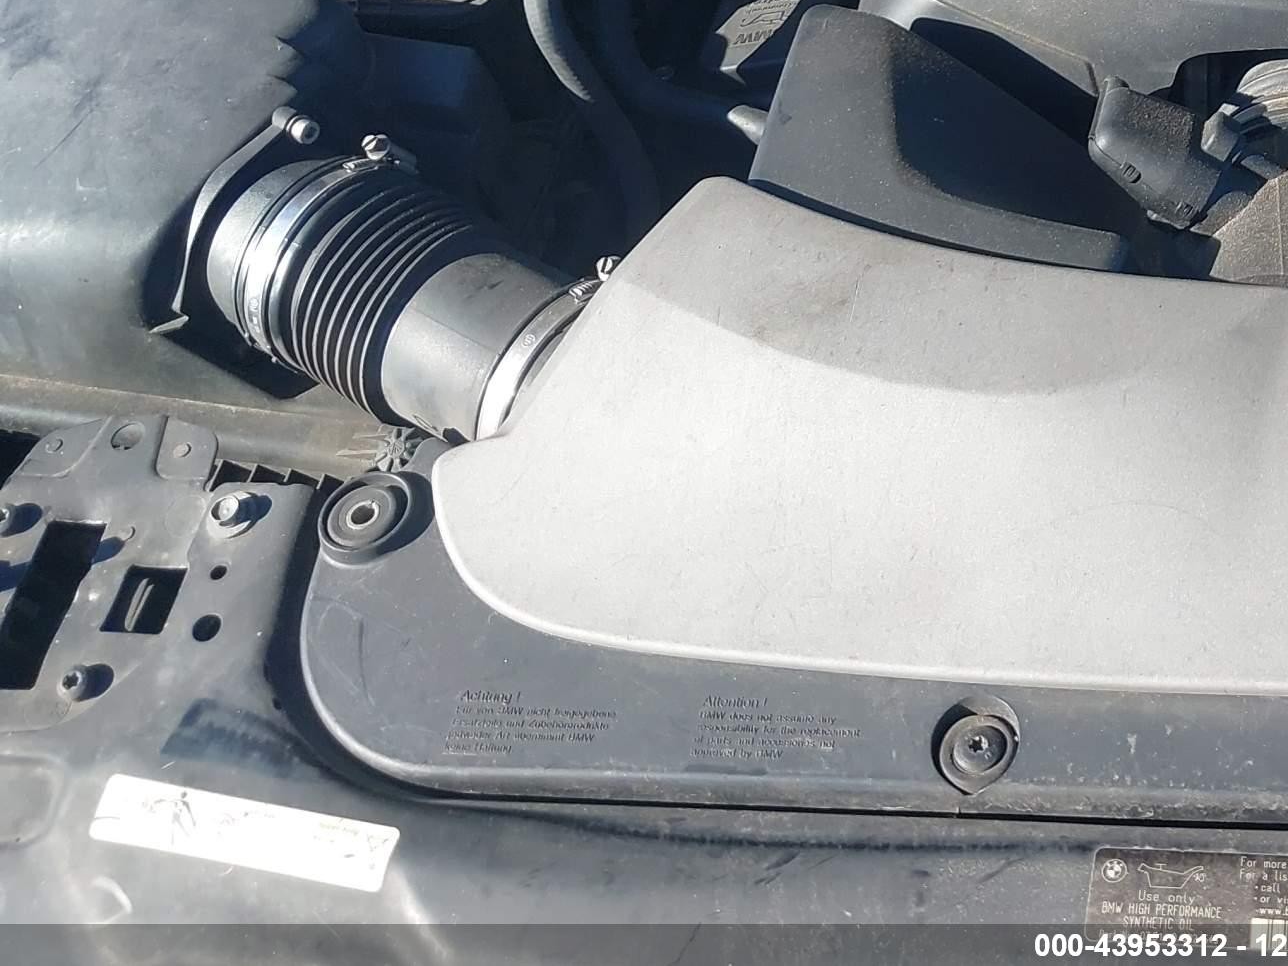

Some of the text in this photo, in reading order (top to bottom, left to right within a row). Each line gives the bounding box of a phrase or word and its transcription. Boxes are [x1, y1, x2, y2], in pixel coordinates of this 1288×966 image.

[1240, 856, 1257, 867] For
[1263, 861, 1287, 869] more
[1239, 870, 1257, 881] For
[1262, 873, 1268, 881] a
[1261, 882, 1281, 892] call
[1138, 890, 1196, 905] Use only
[1101, 901, 1222, 919] BMW HIGH PERFORMANCE
[1122, 915, 1195, 931] SYNTHETIC OIL
